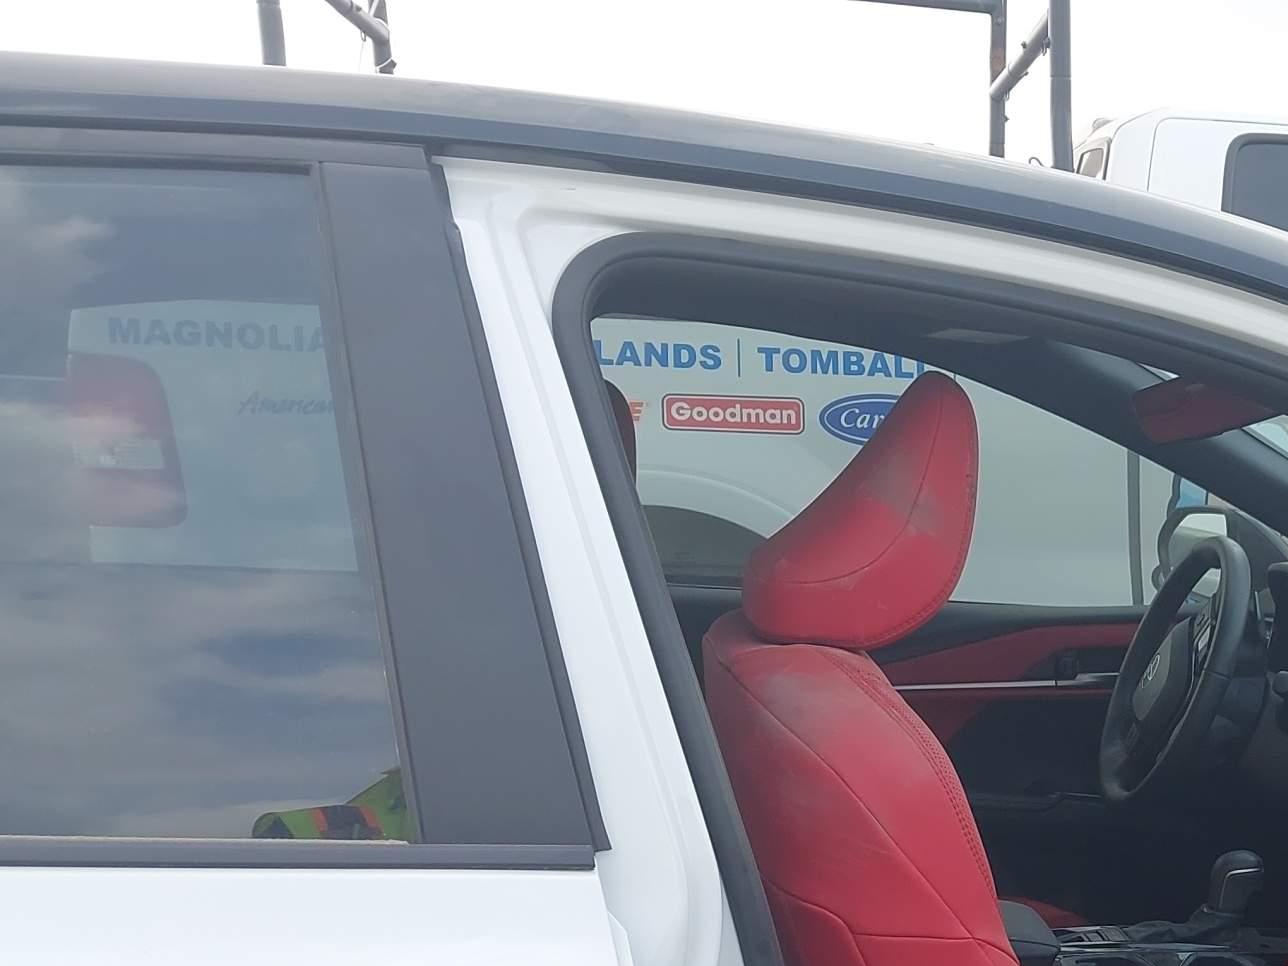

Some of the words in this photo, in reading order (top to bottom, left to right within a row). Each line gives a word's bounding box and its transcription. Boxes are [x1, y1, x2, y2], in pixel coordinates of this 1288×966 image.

[108, 316, 325, 353] MAGNOLIA
[592, 338, 723, 371] LANDS
[670, 400, 797, 426] Goodman
